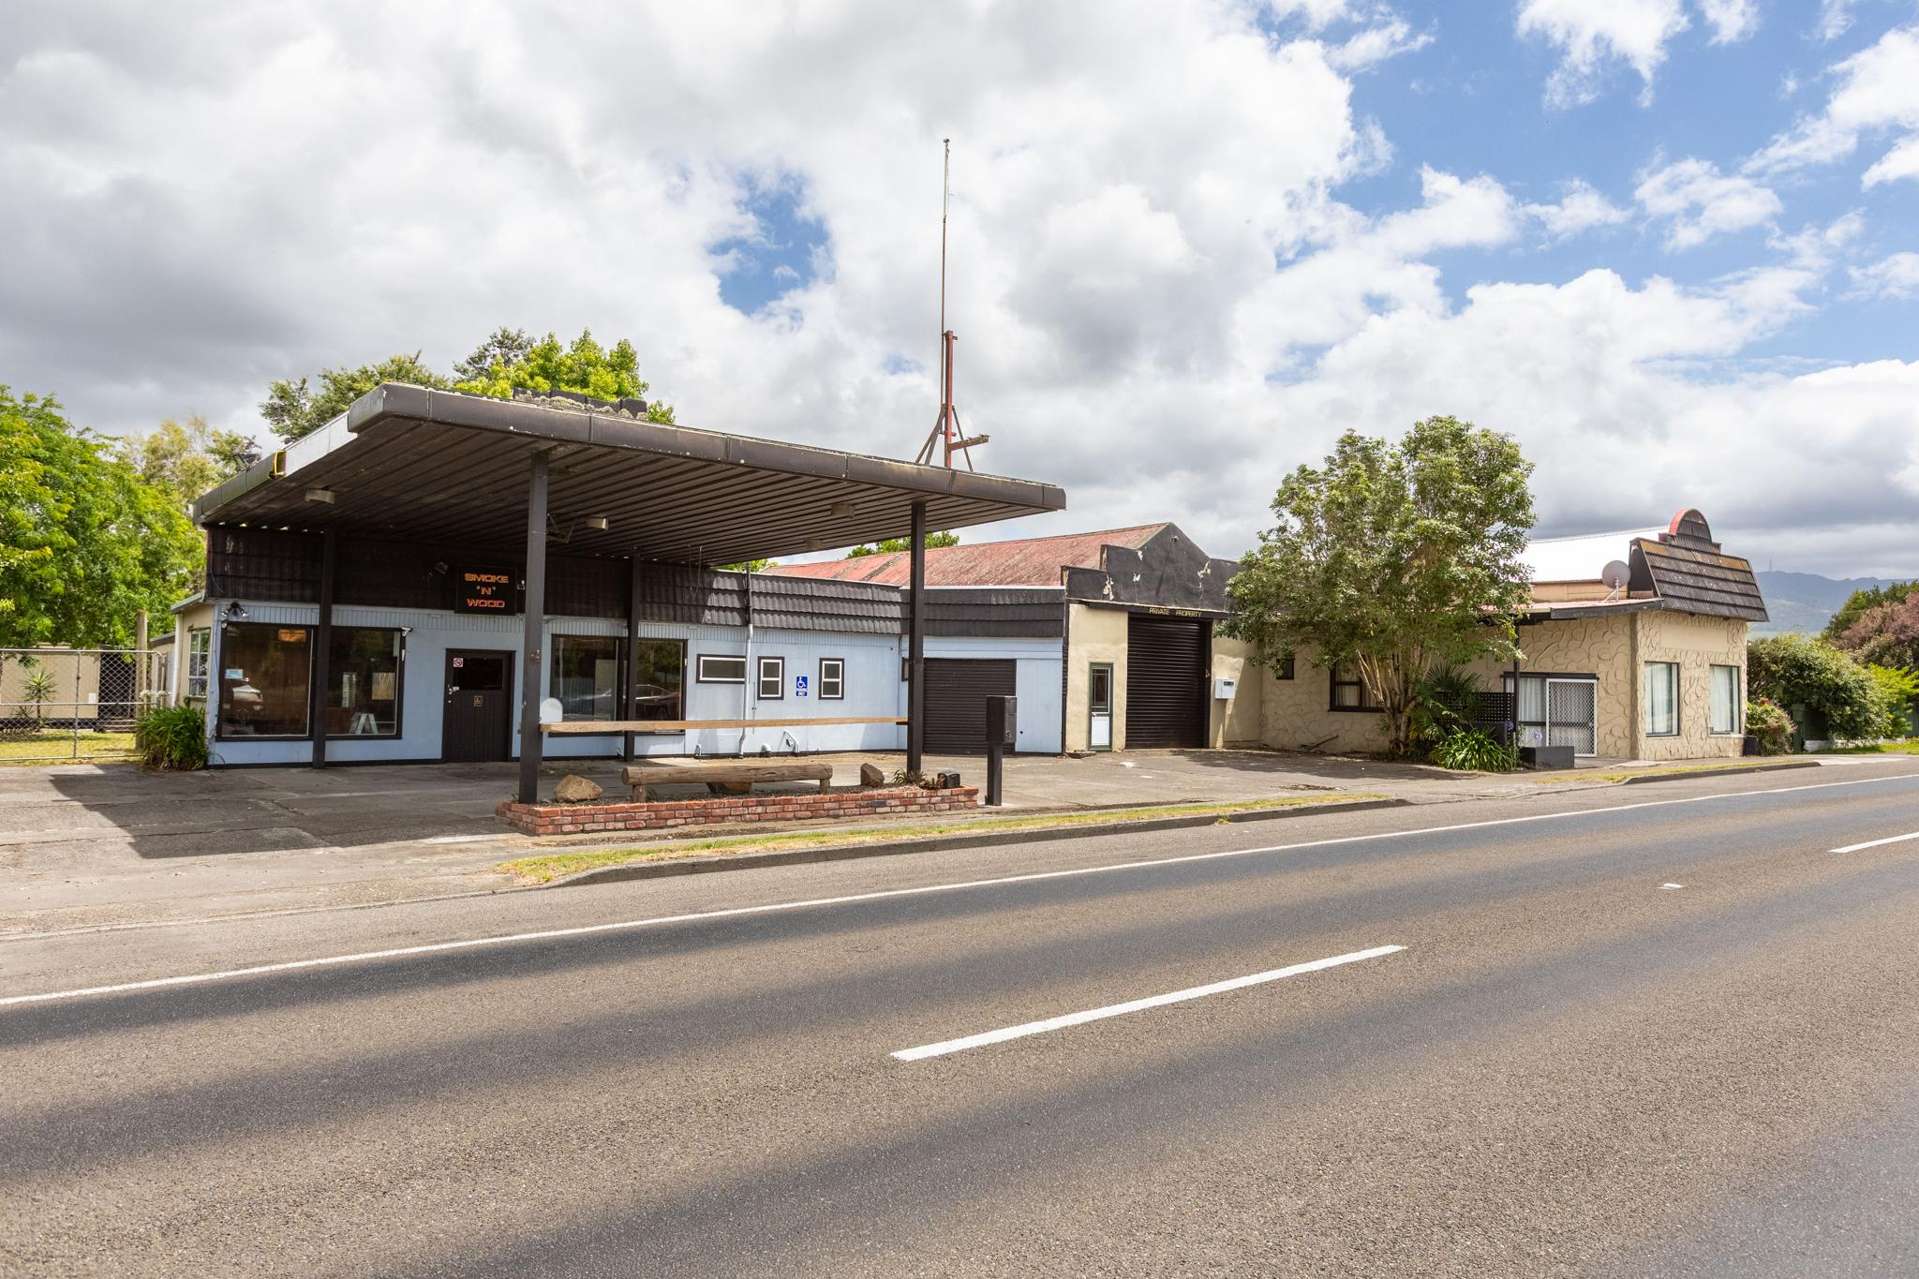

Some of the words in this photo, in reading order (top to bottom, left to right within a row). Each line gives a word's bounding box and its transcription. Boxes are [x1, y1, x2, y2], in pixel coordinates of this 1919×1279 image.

[464, 573, 509, 583] SMOKE
[466, 598, 505, 608] WOOD
[1149, 607, 1170, 616] PRIVATE
[1175, 609, 1201, 617] PROPERTY
